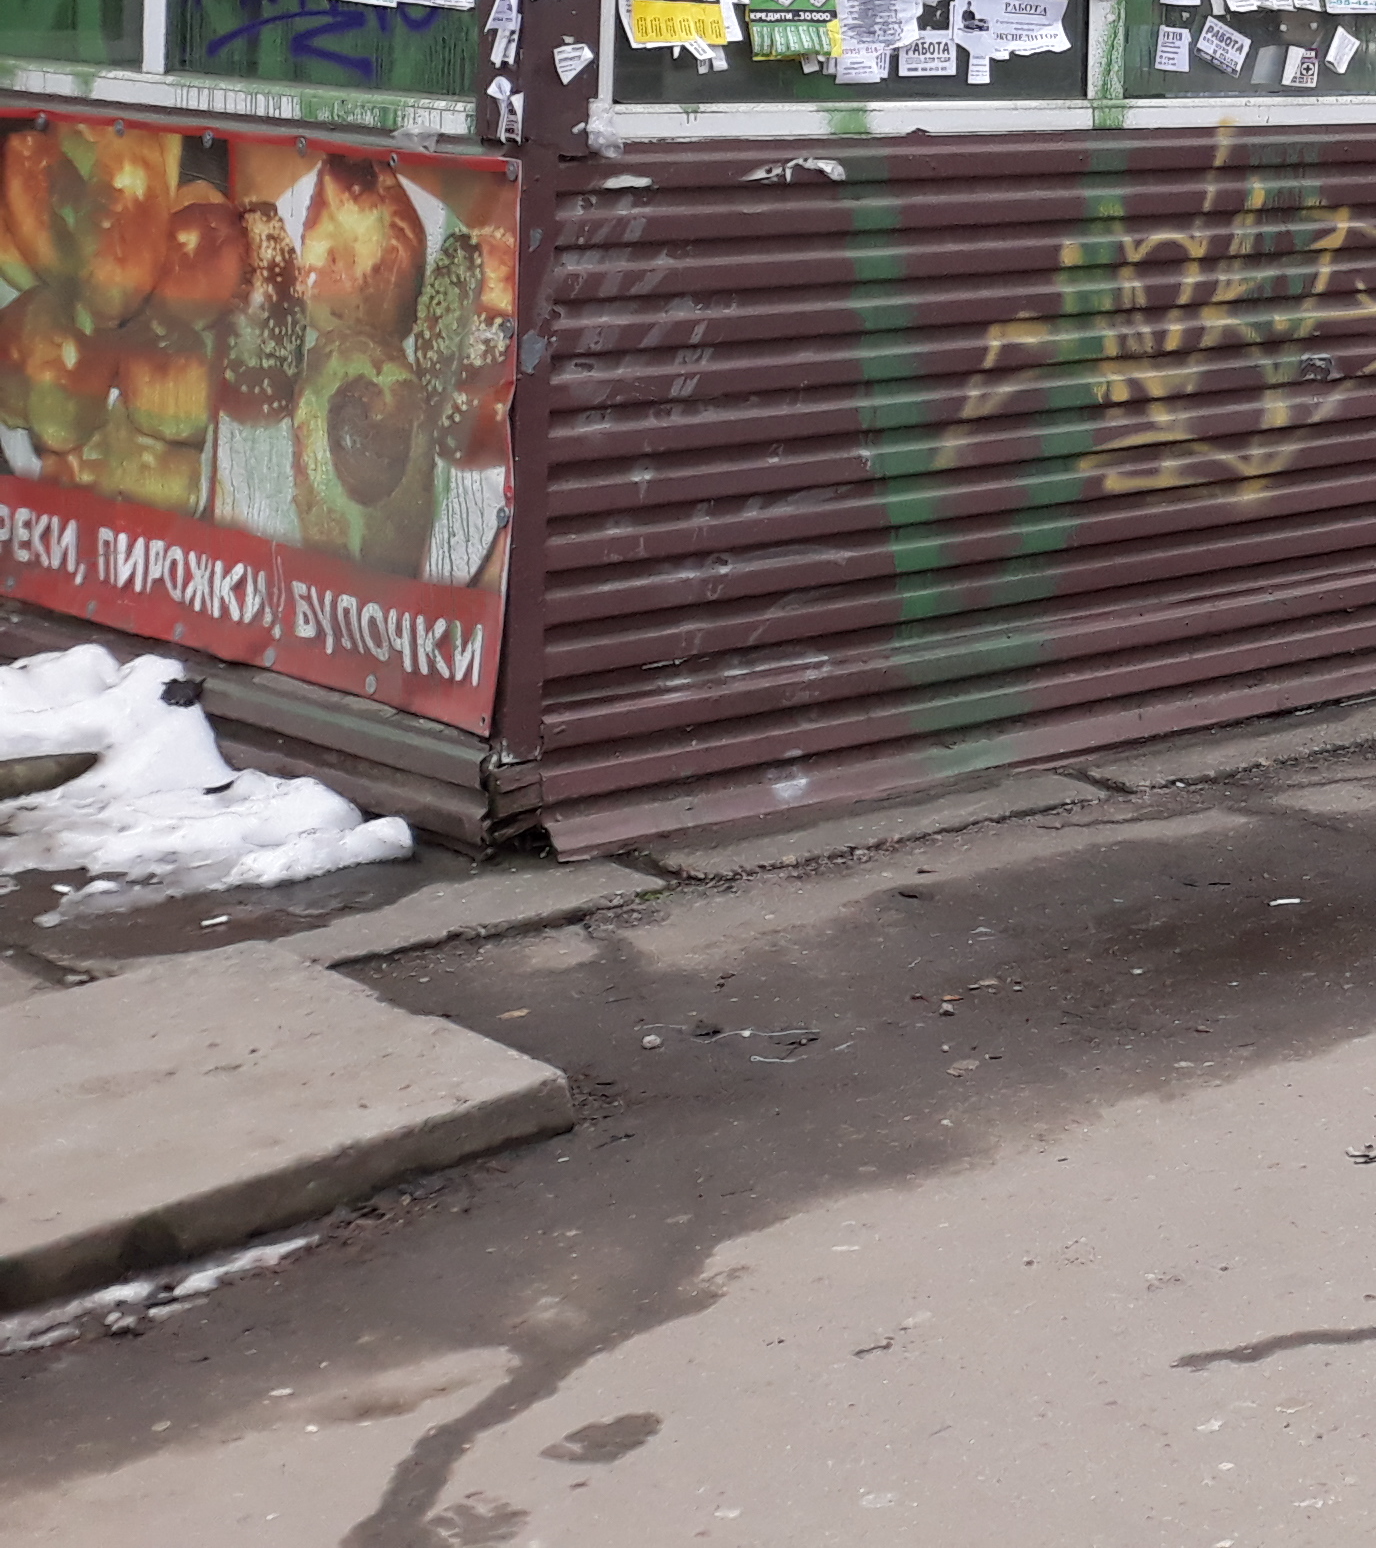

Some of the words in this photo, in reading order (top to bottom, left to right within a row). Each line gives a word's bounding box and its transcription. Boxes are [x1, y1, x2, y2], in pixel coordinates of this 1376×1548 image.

[1005, 2, 1047, 16] РАБОТА
[750, 11, 793, 22] КРЕДИТИ
[993, 31, 1059, 44] ЭКСПЕДИТОР
[1205, 24, 1244, 56] РАБОТА
[906, 41, 950, 56] РАБОТА
[290, 579, 484, 688] БУЛОЧКИ
